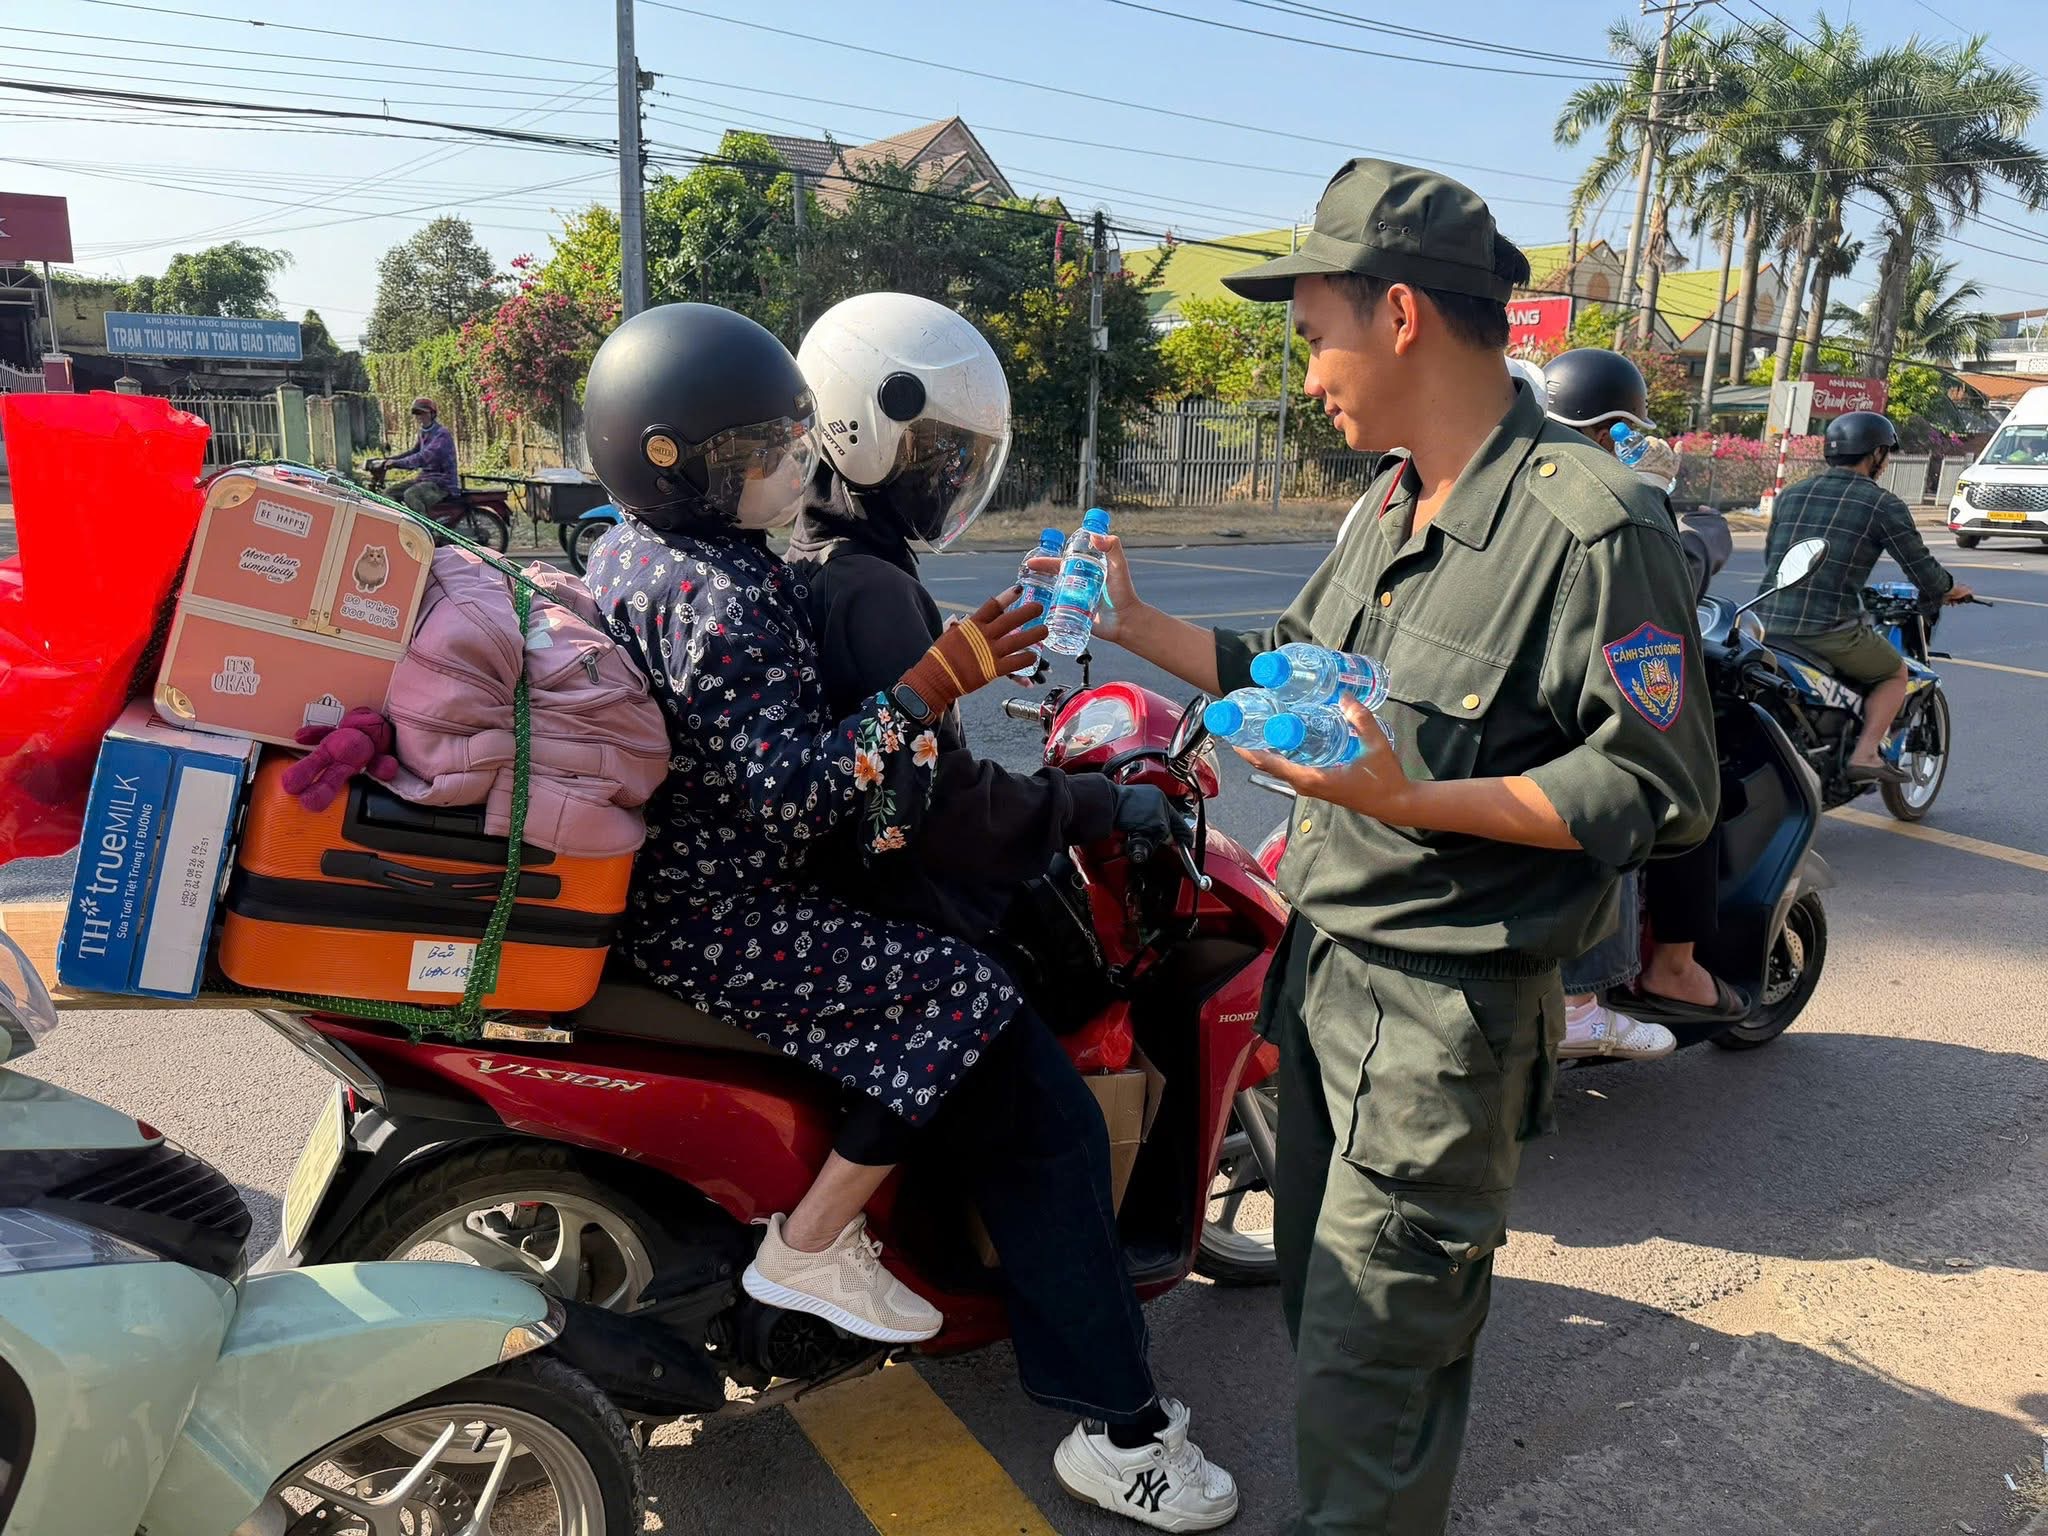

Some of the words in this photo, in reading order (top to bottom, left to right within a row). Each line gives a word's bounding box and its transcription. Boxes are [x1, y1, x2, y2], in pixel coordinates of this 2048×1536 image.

[146, 317, 162, 325] KHO
[112, 327, 143, 350] TRẠM
[144, 329, 165, 348] THU
[166, 329, 193, 352] PHẠT
[196, 331, 209, 350] AN
[211, 329, 239, 352] TOÀN
[240, 333, 264, 352] GIAO
[265, 331, 296, 353] THÔNG
[260, 509, 272, 520] BE
[276, 513, 306, 530] HAPPY
[243, 548, 271, 563] More
[273, 553, 299, 567] than
[241, 561, 296, 579] simplicity
[368, 611, 398, 629] love
[1613, 646, 1638, 663] CẢNH
[1638, 643, 1655, 658] SÁT
[226, 658, 251, 673] IT'S
[214, 673, 258, 693] OKAY
[189, 858, 197, 867] 26
[197, 859, 205, 868] 26
[187, 868, 194, 877] 08
[195, 870, 202, 878] 01
[125, 880, 138, 898] Tiệt
[184, 879, 192, 887] 31
[121, 899, 133, 920] Tươi
[117, 921, 129, 939] Sữa
[79, 919, 112, 960] TH
[474, 1057, 646, 1092] VISION
